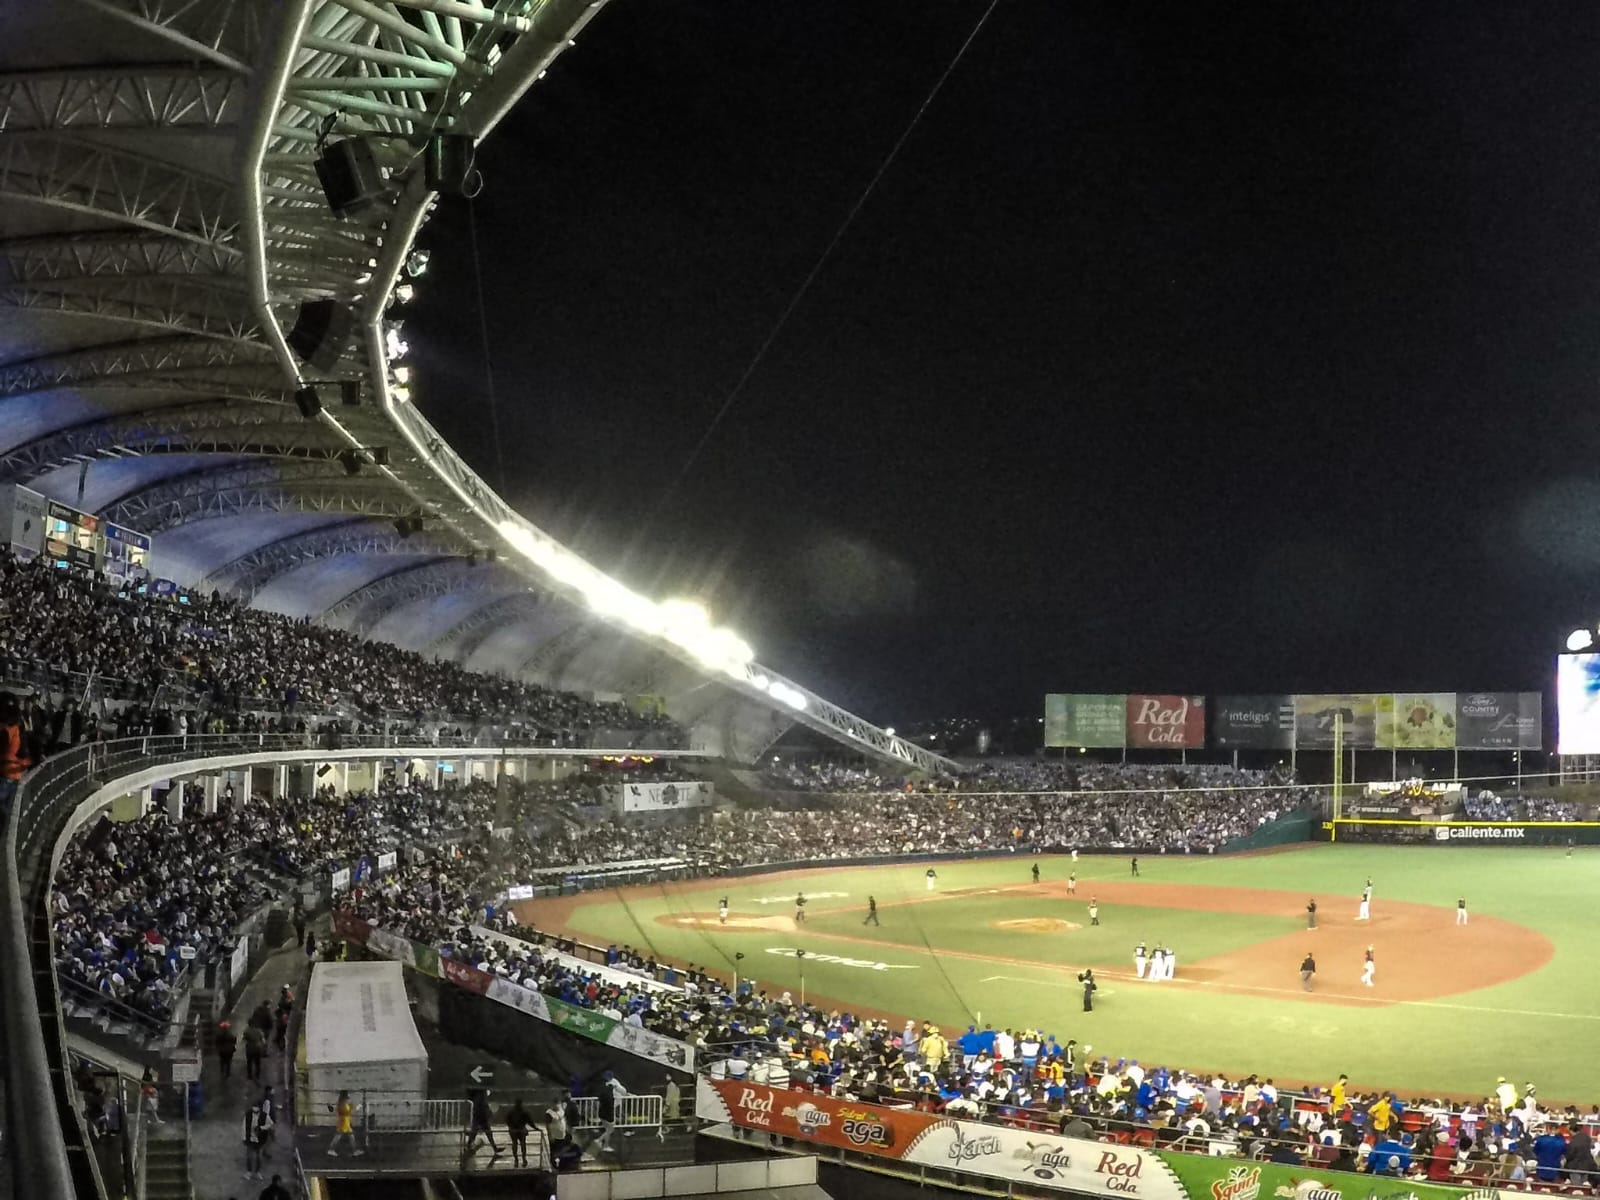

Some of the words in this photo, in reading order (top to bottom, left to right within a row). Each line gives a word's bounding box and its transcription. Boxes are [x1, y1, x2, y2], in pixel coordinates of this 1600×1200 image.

[1134, 698, 1189, 725] Red
[1148, 726, 1184, 743] Cola
[1450, 826, 1525, 838] caliente.mx
[737, 1087, 774, 1113] Red
[746, 1111, 770, 1126] Cola
[805, 1110, 830, 1126] aga
[836, 1107, 866, 1120] Sidral
[841, 1119, 885, 1145] aga
[1041, 1152, 1071, 1169] aga
[1095, 1151, 1142, 1179] Red
[1106, 1177, 1137, 1194] Cola
[1211, 1167, 1261, 1200] Squirt
